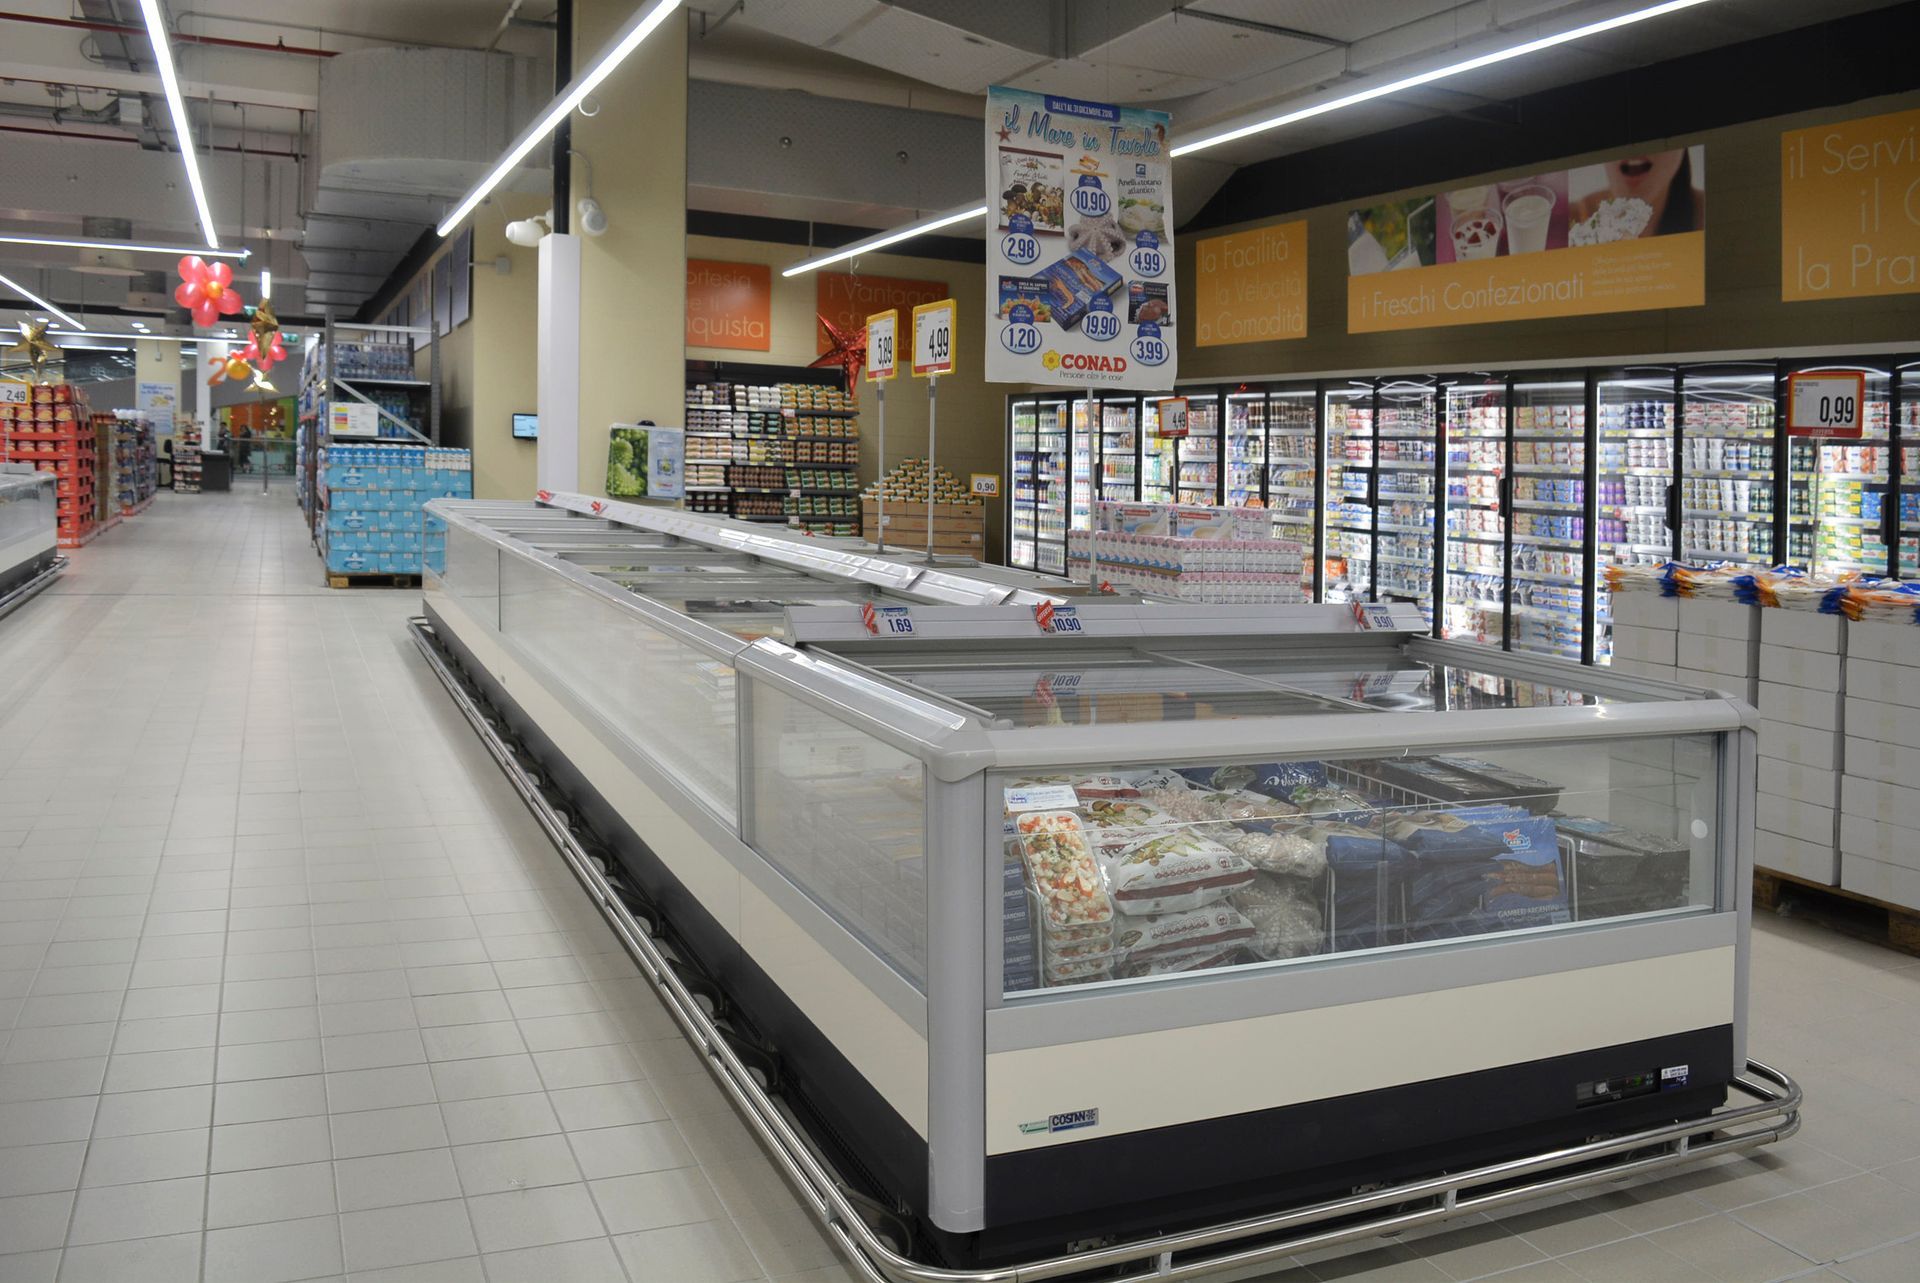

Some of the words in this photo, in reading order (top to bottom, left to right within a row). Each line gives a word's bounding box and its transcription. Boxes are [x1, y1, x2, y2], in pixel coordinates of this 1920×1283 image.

[1028, 111, 1075, 148] Mare
[1082, 132, 1099, 152] in
[1109, 126, 1159, 156] Tavola
[1789, 136, 1804, 179] il
[1822, 127, 1916, 175] Servi
[1075, 190, 1107, 213] 10,90
[1860, 177, 1879, 234] il
[1007, 237, 1035, 260] 2,98
[1201, 242, 1216, 273] la
[1223, 231, 1288, 269] Facilità
[1134, 252, 1160, 273] 4,99
[1798, 246, 1831, 292] la
[1362, 296, 1367, 319] i
[1373, 286, 1437, 320] Freschi
[1443, 272, 1584, 312] Confezionati
[1086, 315, 1116, 337] 19,90
[1216, 303, 1304, 340] Comodità
[929, 327, 949, 362] 4,99
[1009, 328, 1035, 349] 1,20
[878, 336, 892, 368] 5,89
[1136, 340, 1163, 361] 3,99
[1061, 354, 1127, 373] CONAD
[6, 390, 26, 403] 2,49
[1820, 396, 1854, 427] 0,99
[977, 482, 995, 492] 0,90
[888, 618, 913, 633] 1,69
[1053, 617, 1081, 632] 10,90
[1052, 1110, 1086, 1127] COSTAN
